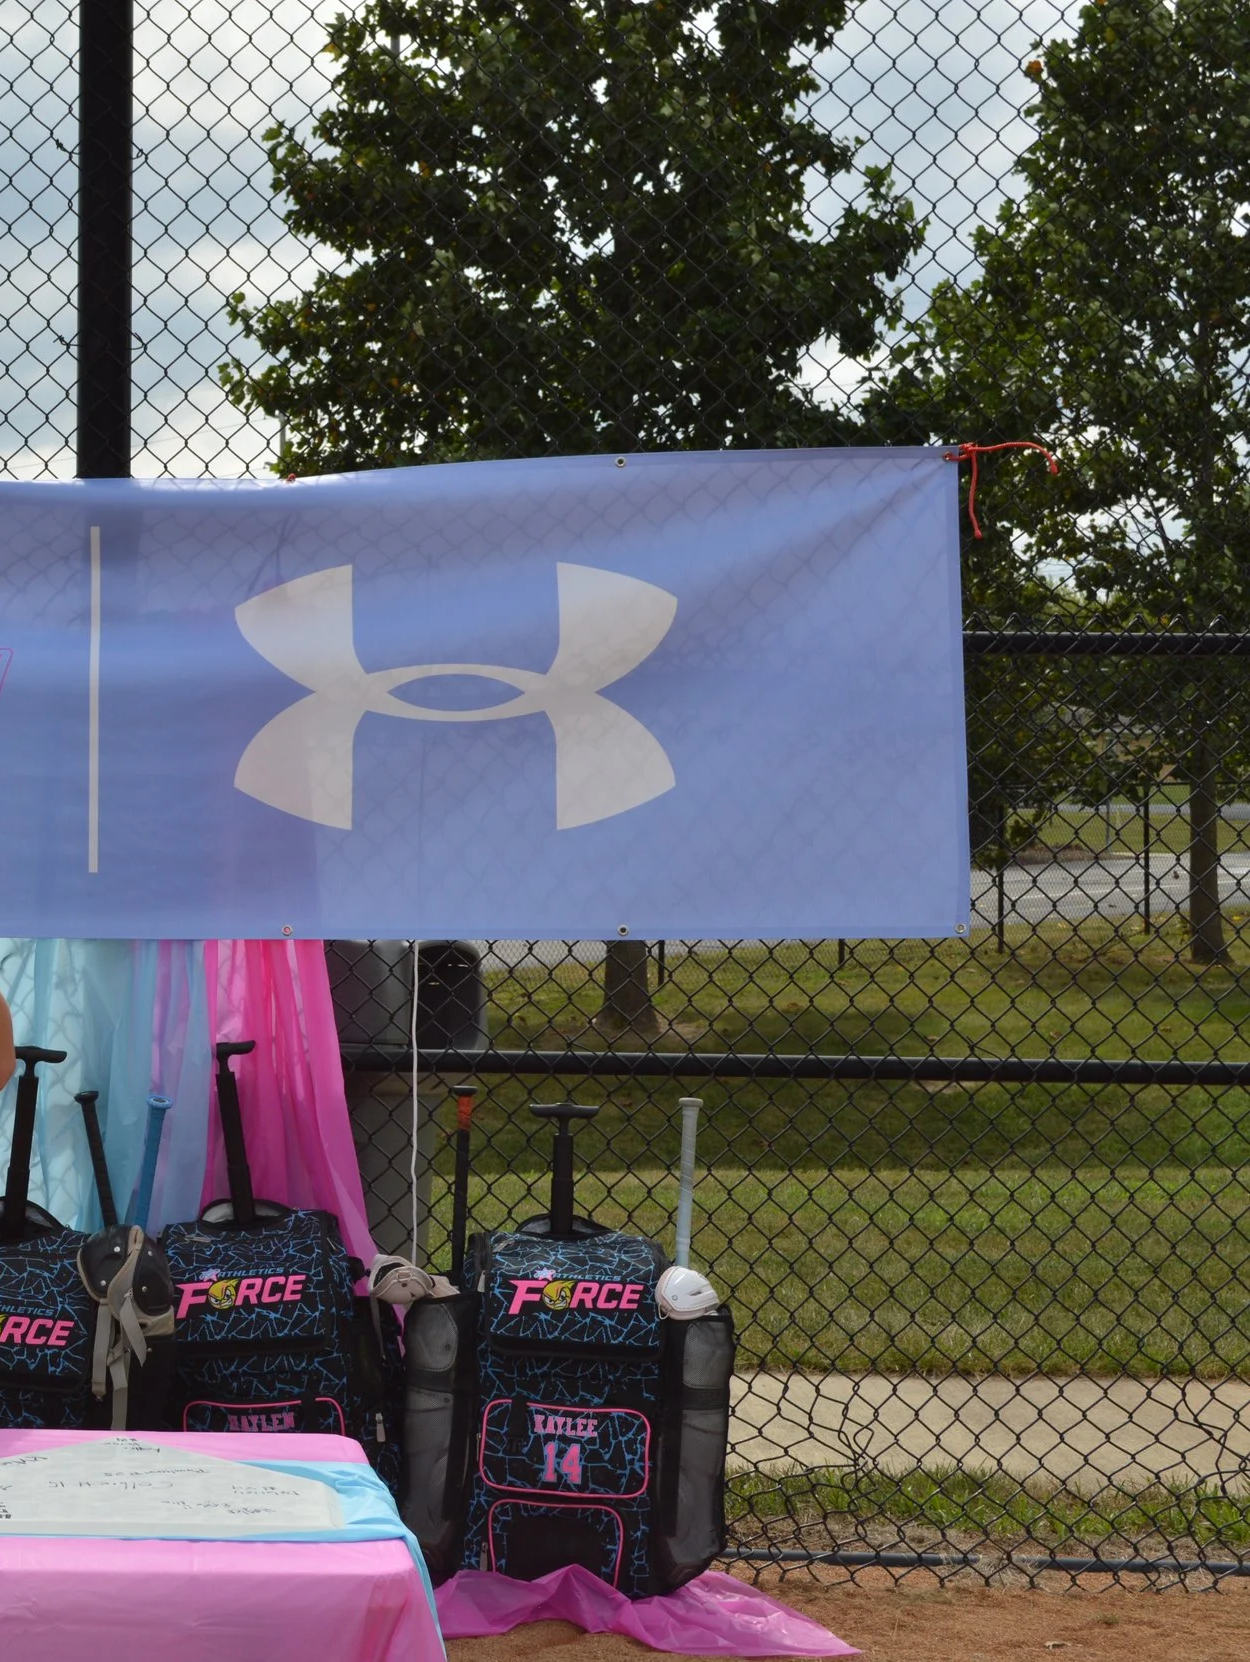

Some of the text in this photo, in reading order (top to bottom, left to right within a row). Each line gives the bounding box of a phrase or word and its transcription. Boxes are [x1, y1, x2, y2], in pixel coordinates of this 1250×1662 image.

[217, 1266, 285, 1278] ATHLETICS
[532, 1413, 599, 1438] KAYLEE
[542, 1442, 582, 1485] 14
